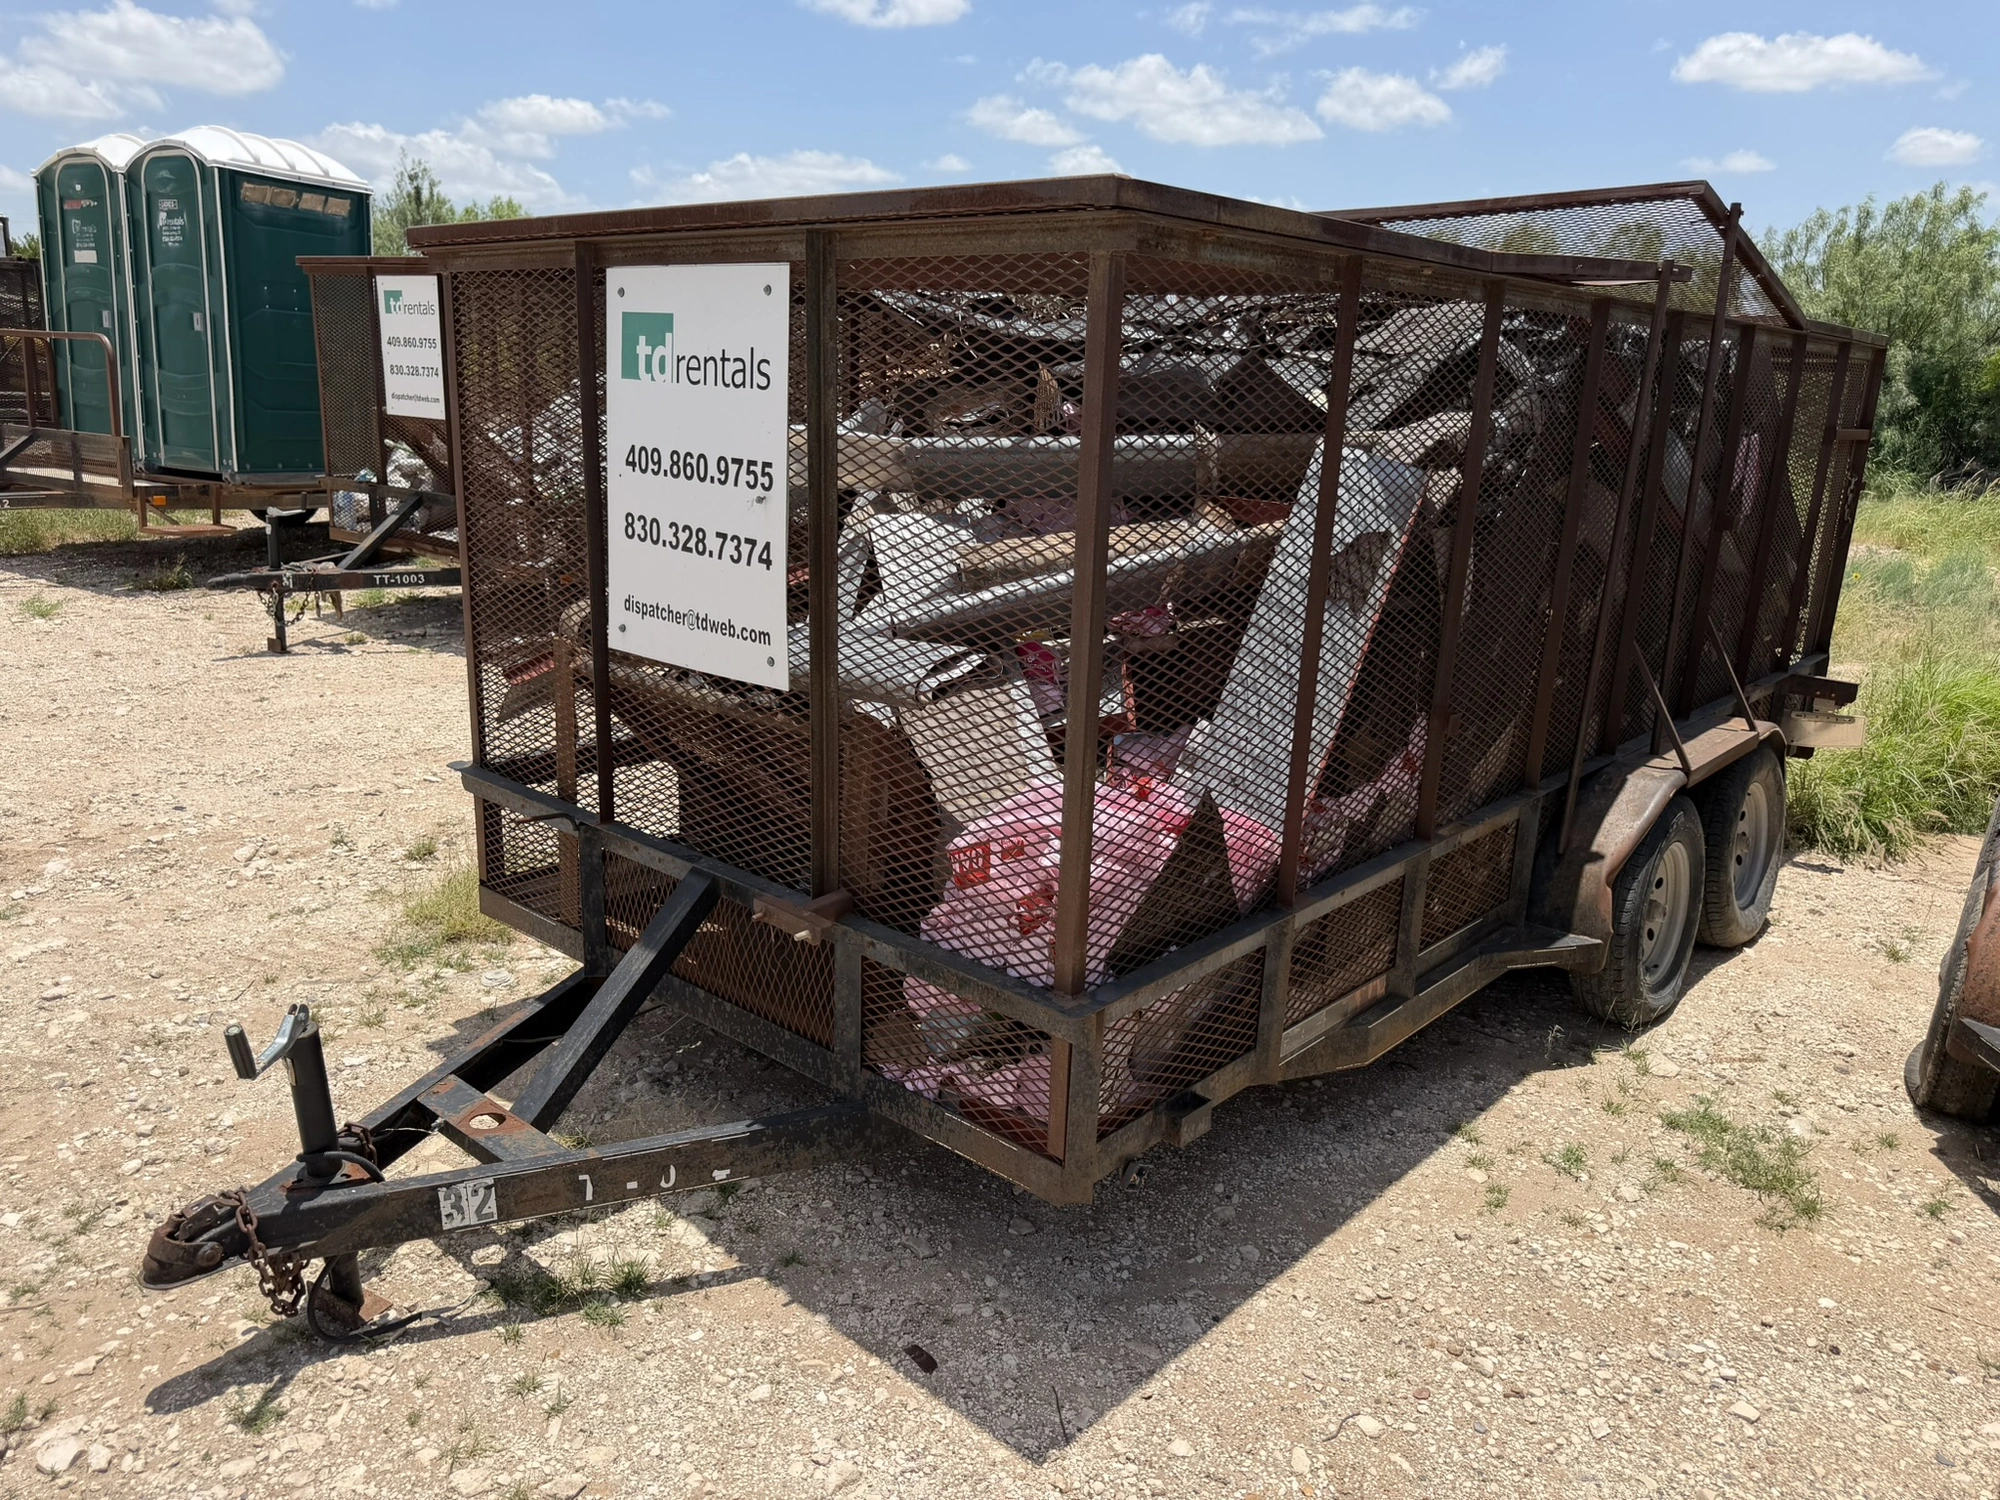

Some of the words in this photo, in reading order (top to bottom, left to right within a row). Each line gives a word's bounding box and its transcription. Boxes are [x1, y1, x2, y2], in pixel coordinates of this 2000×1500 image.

[387, 336, 437, 349] 409.860.9755
[389, 364, 439, 377] 830.328.7374
[625, 444, 774, 492] 409.860.9755
[624, 512, 773, 571] 830.328.7374
[373, 574, 425, 585] TT-1003
[624, 594, 771, 646] dispatcher@tdweb.com
